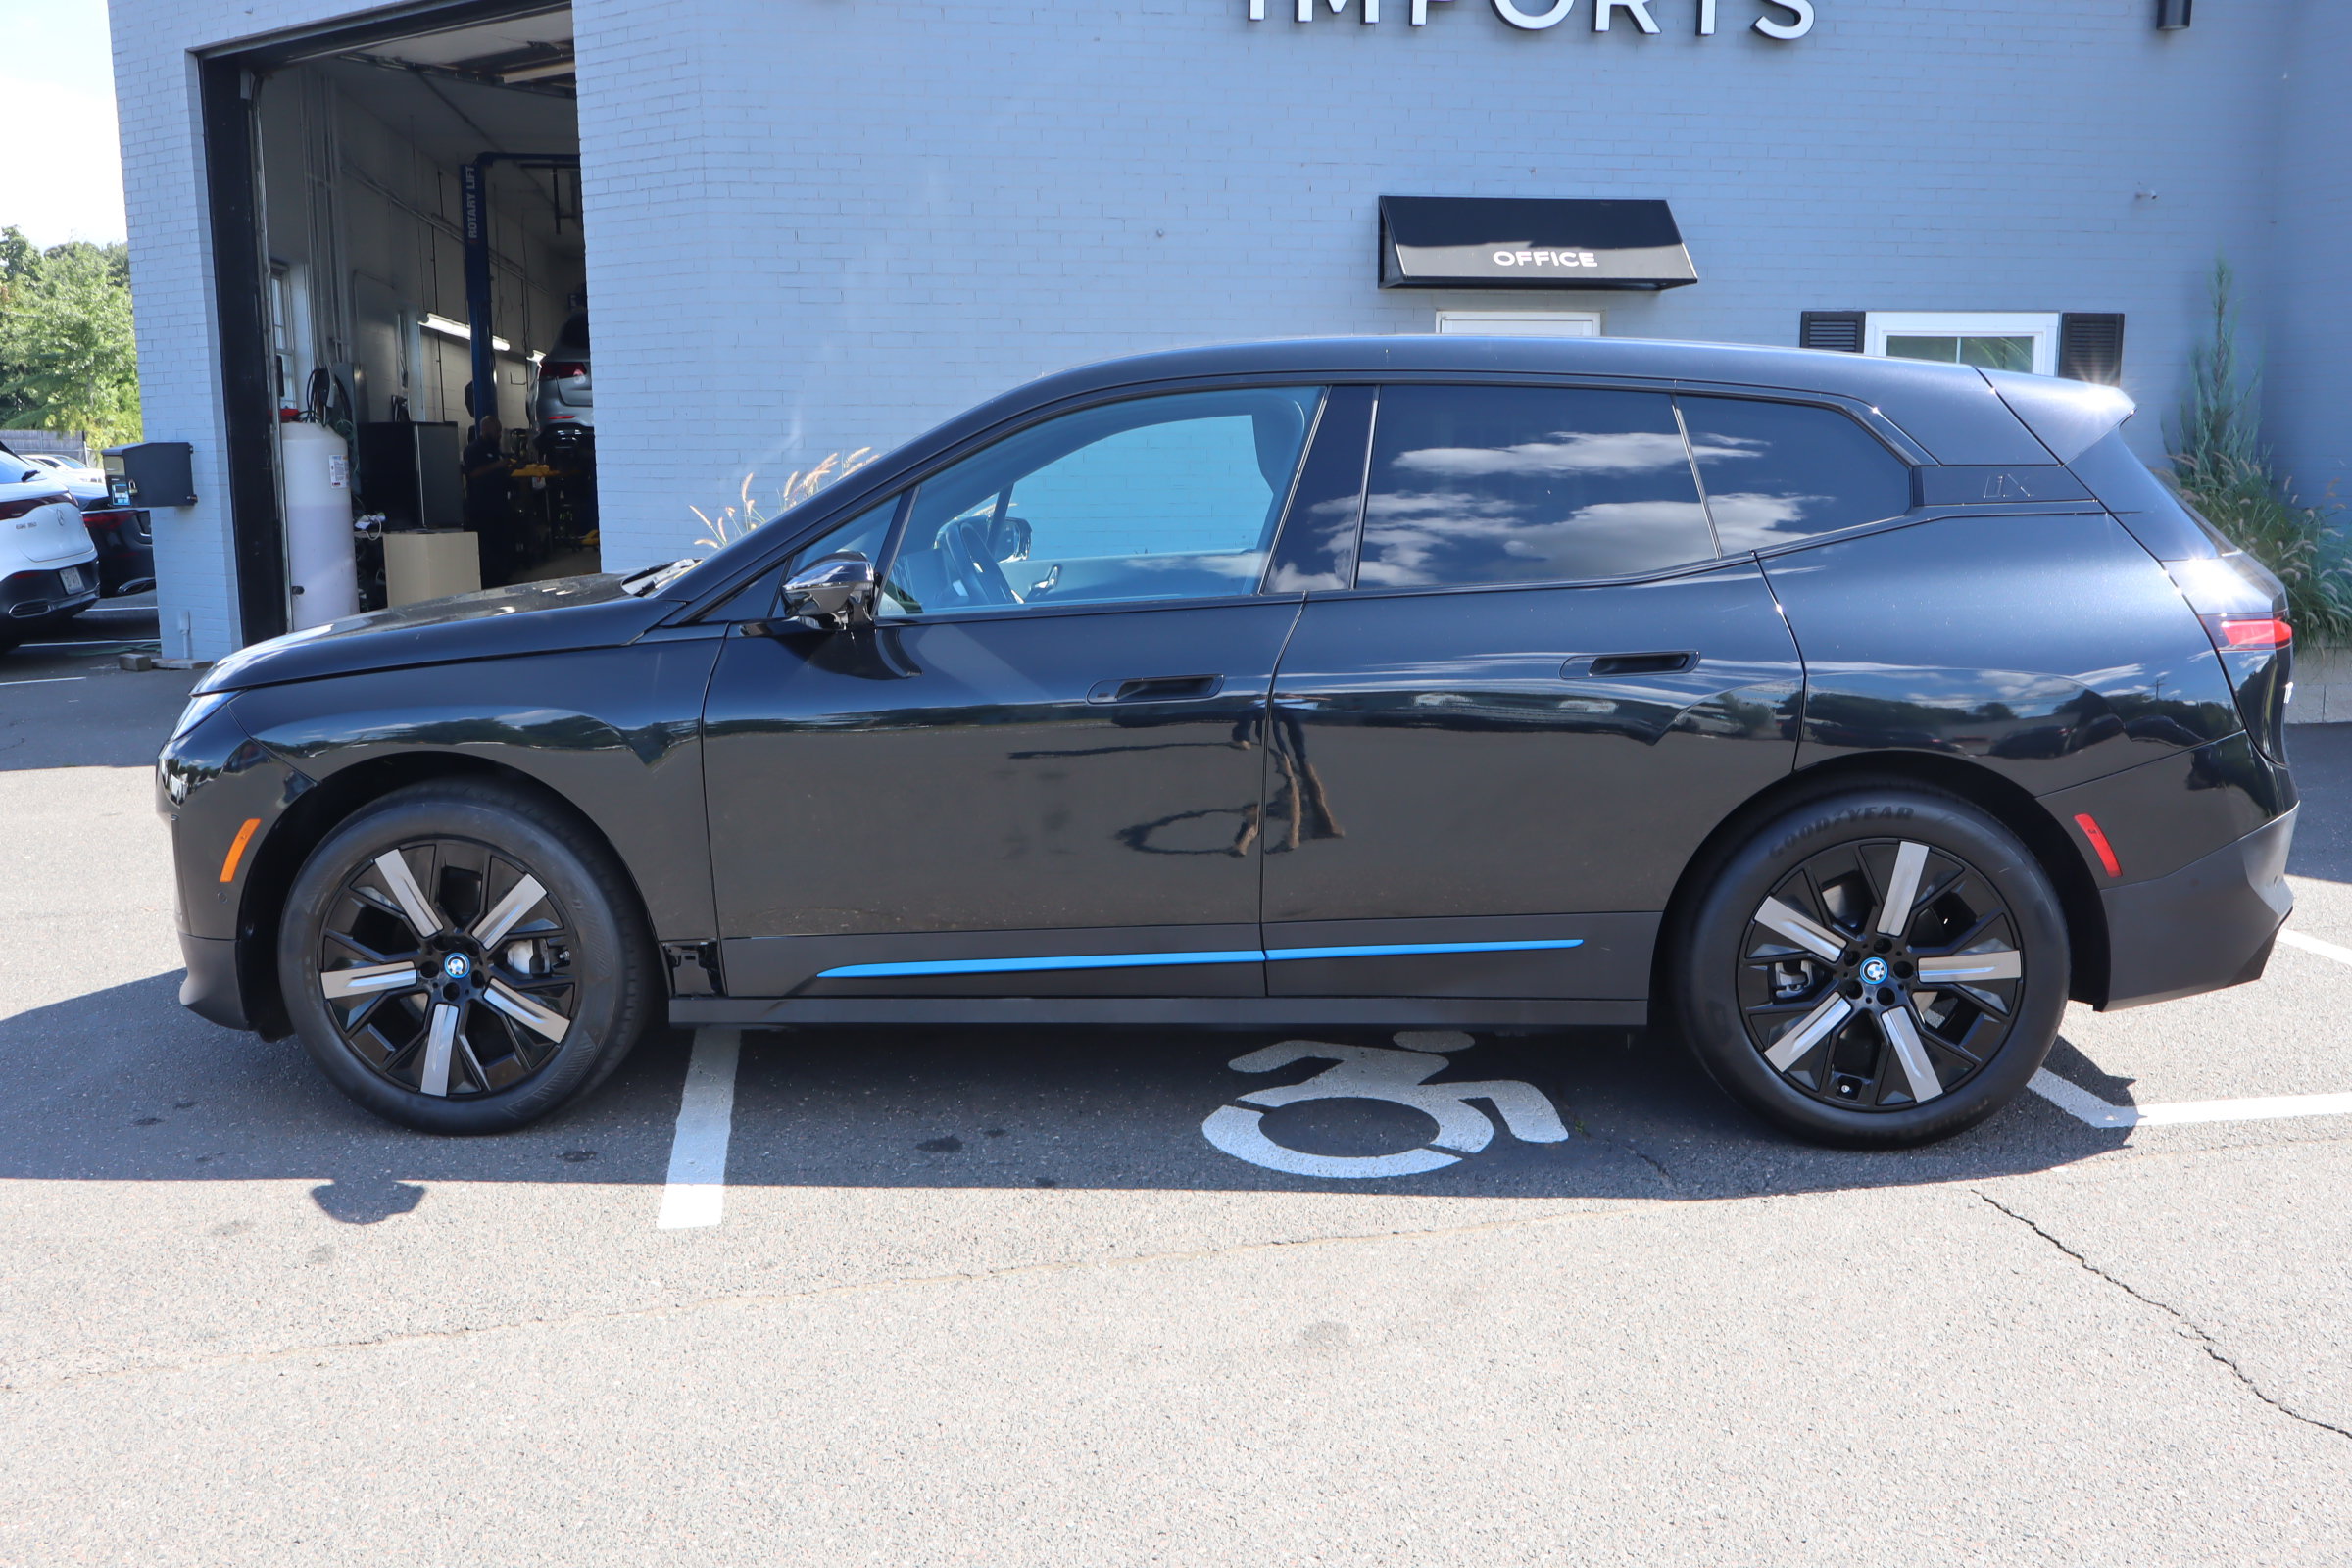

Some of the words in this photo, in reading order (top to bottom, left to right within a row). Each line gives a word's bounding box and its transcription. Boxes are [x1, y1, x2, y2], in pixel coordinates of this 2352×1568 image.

[466, 165, 476, 190] LIFT
[466, 193, 478, 239] ROTARY
[1493, 251, 1598, 267] OFFICE
[1769, 806, 1915, 857] GOODYEAR
